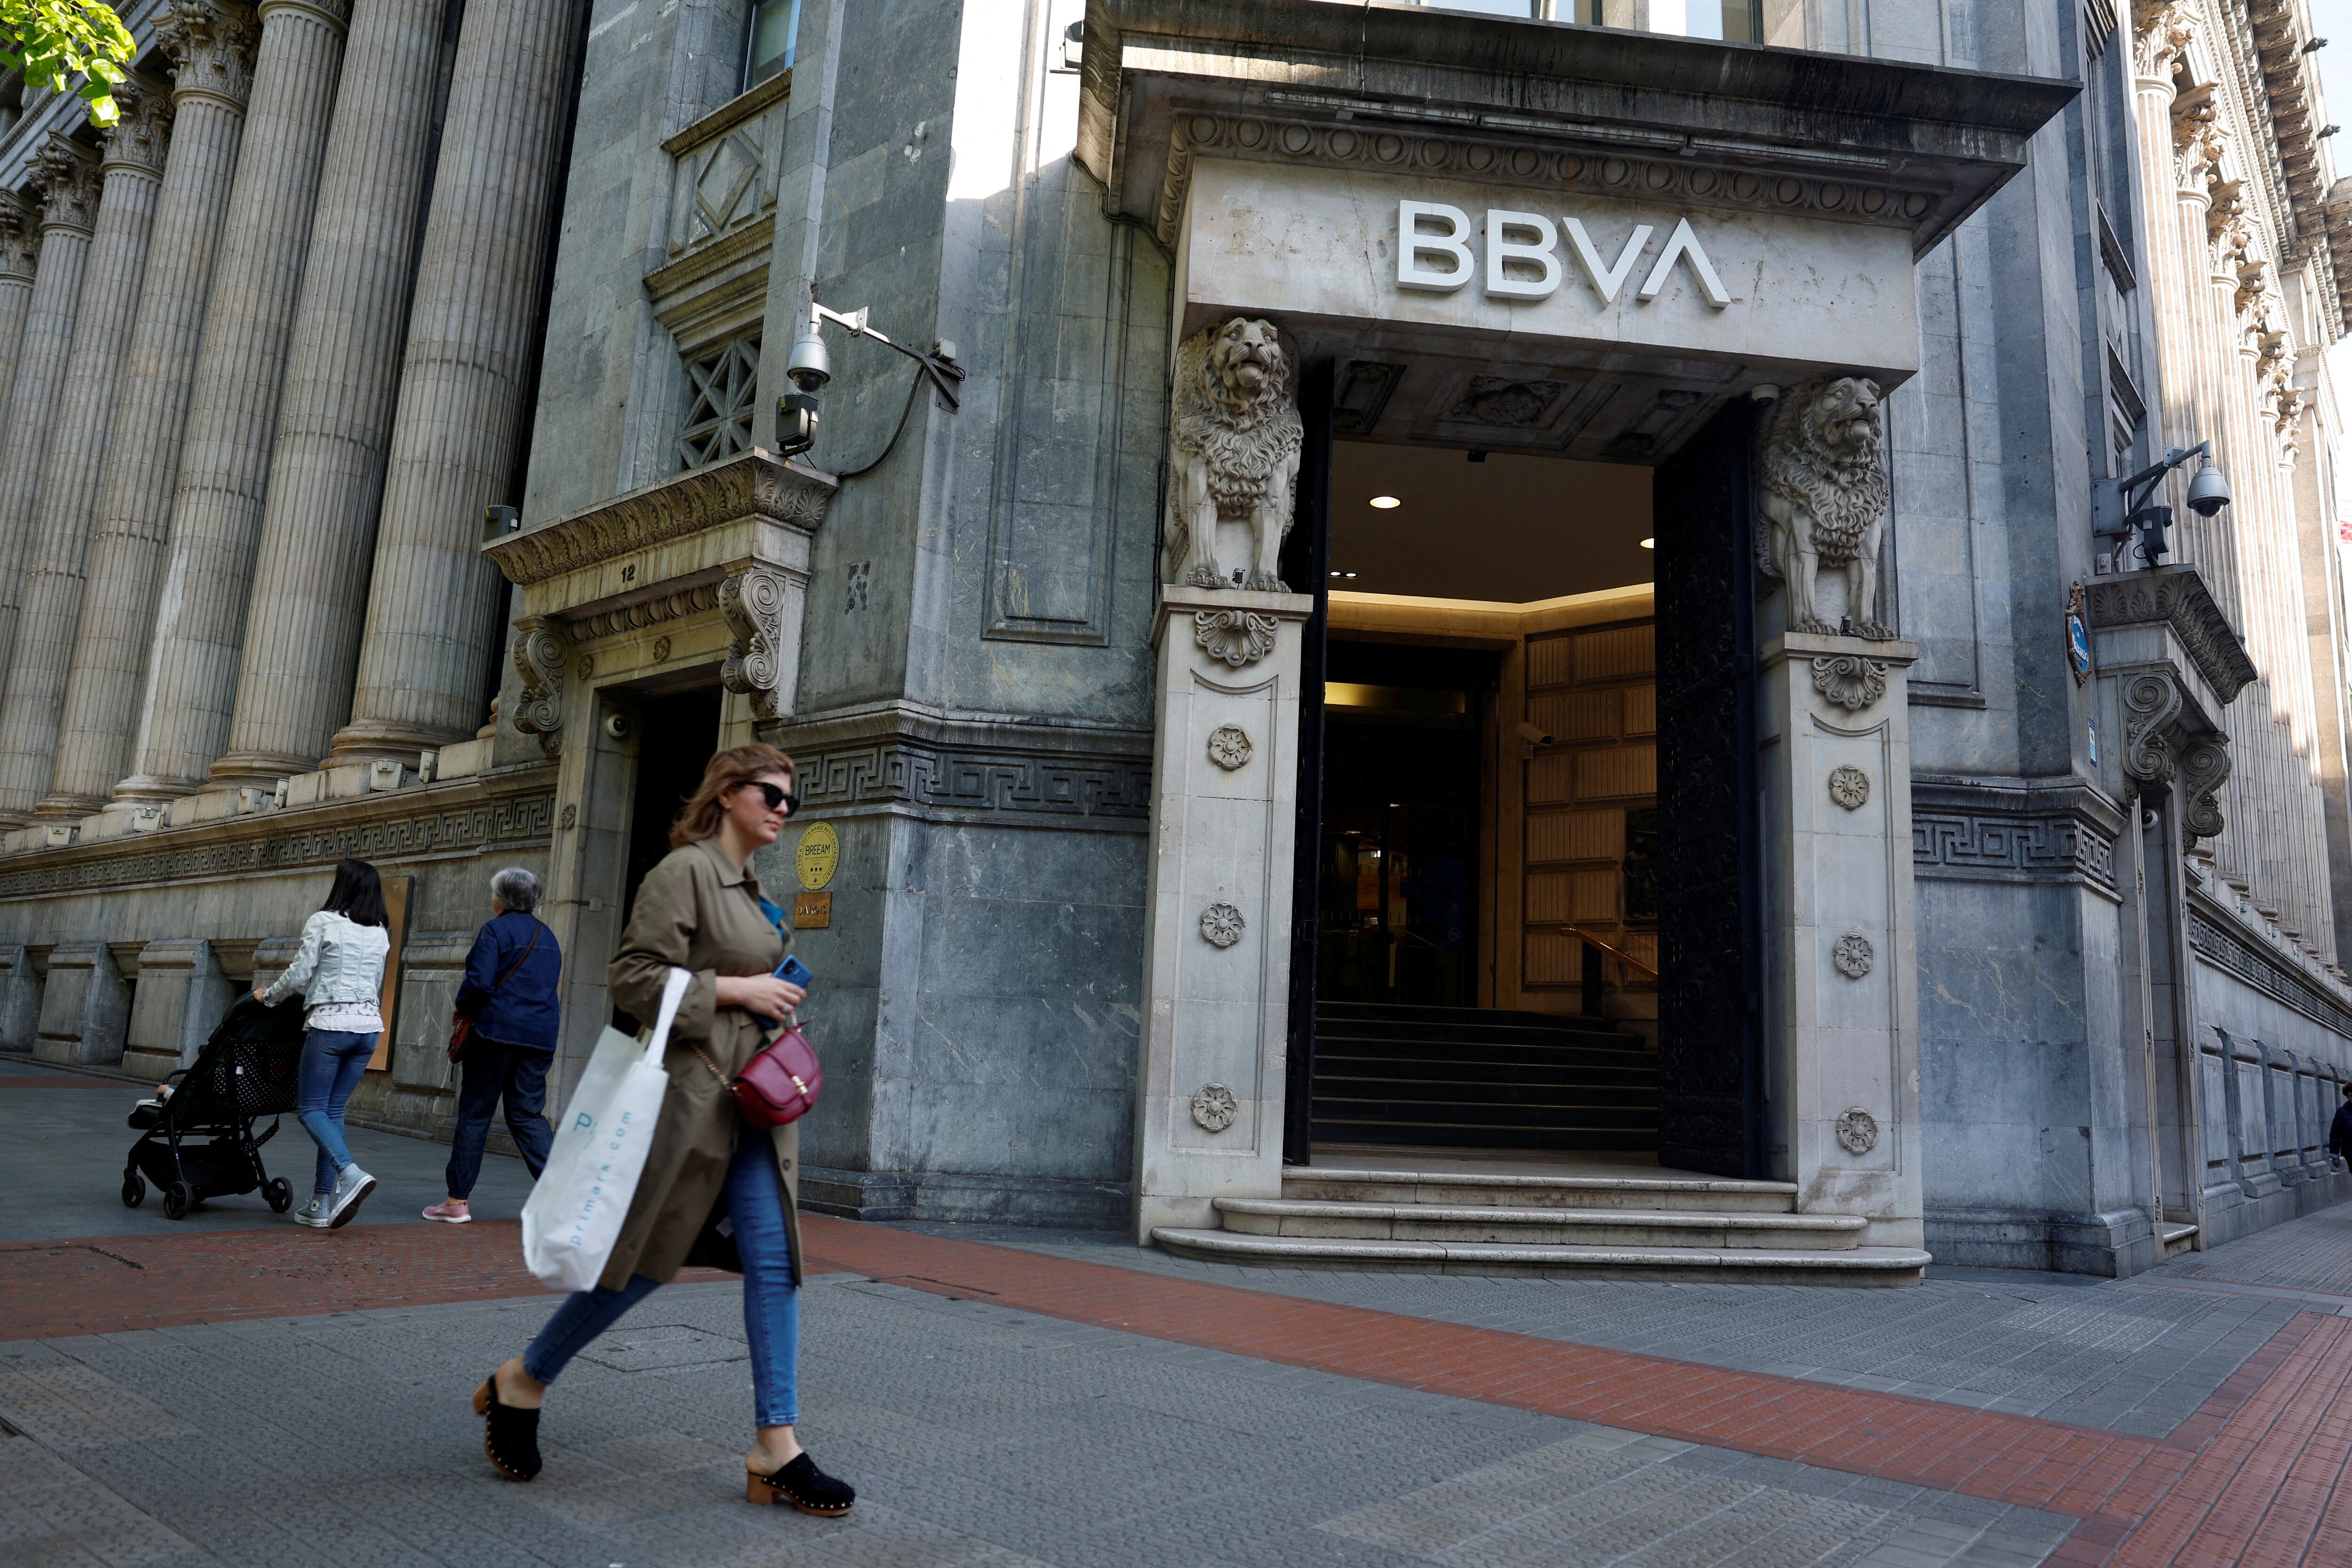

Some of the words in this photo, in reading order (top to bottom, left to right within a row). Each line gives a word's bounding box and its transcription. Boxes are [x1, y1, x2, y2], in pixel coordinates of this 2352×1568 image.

[1396, 200, 1731, 308] BBVA
[621, 565, 635, 583] 12
[801, 825, 824, 847] SUSTAINABLE
[825, 827, 834, 837] BUILT
[805, 844, 830, 856] BREEAM
[825, 838, 837, 880] ENVIRONMENT
[571, 1111, 632, 1246] primark.com
